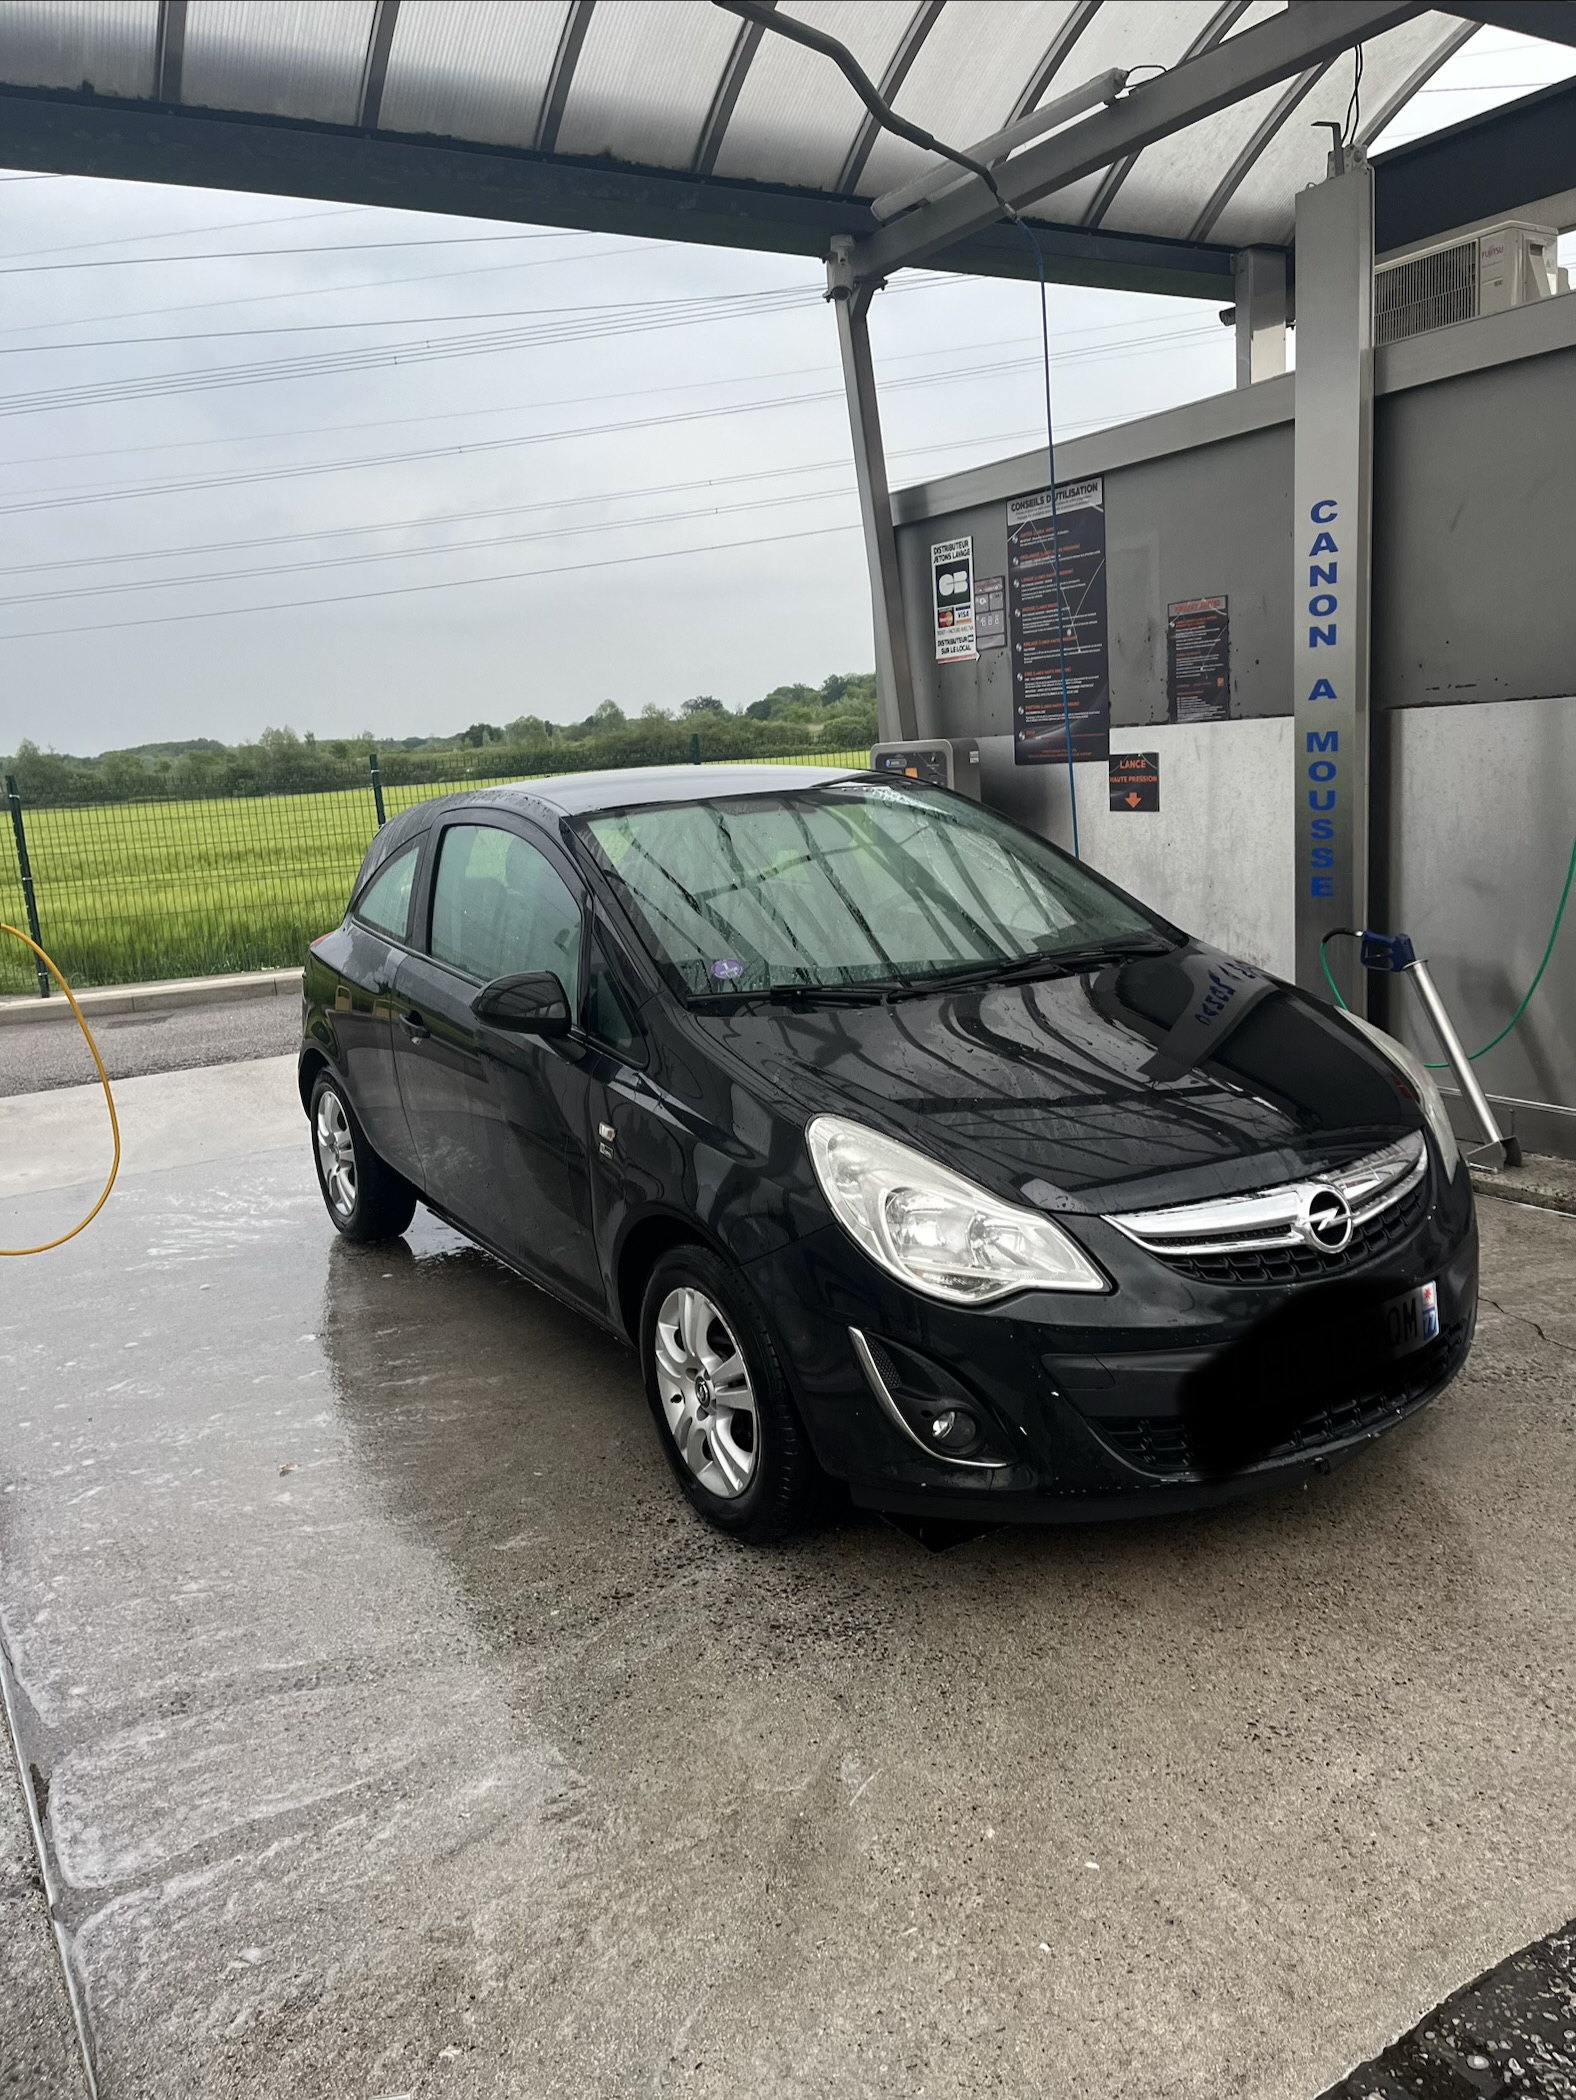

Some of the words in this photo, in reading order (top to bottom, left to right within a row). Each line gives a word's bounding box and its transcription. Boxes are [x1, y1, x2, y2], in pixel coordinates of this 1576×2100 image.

[1481, 245, 1504, 258] FUJITSU
[1011, 496, 1044, 512] CONSEILS
[1046, 482, 1098, 504] DUTILISATION
[933, 539, 969, 555] DISTRIBUTEUR
[933, 552, 952, 564] JETONS
[952, 548, 970, 559] LAVAGE
[1308, 500, 1339, 649] CANON
[957, 610, 970, 619] VISA
[937, 636, 968, 647] DISTRIBUTEUR
[941, 647, 950, 655] SUR
[956, 644, 971, 653] LOCAL
[1308, 678, 1338, 701] A
[1120, 760, 1147, 769] LANCE
[1128, 775, 1158, 783] PRESSION
[1305, 731, 1339, 898] MOUSSE
[1423, 1310, 1437, 1334] 77
